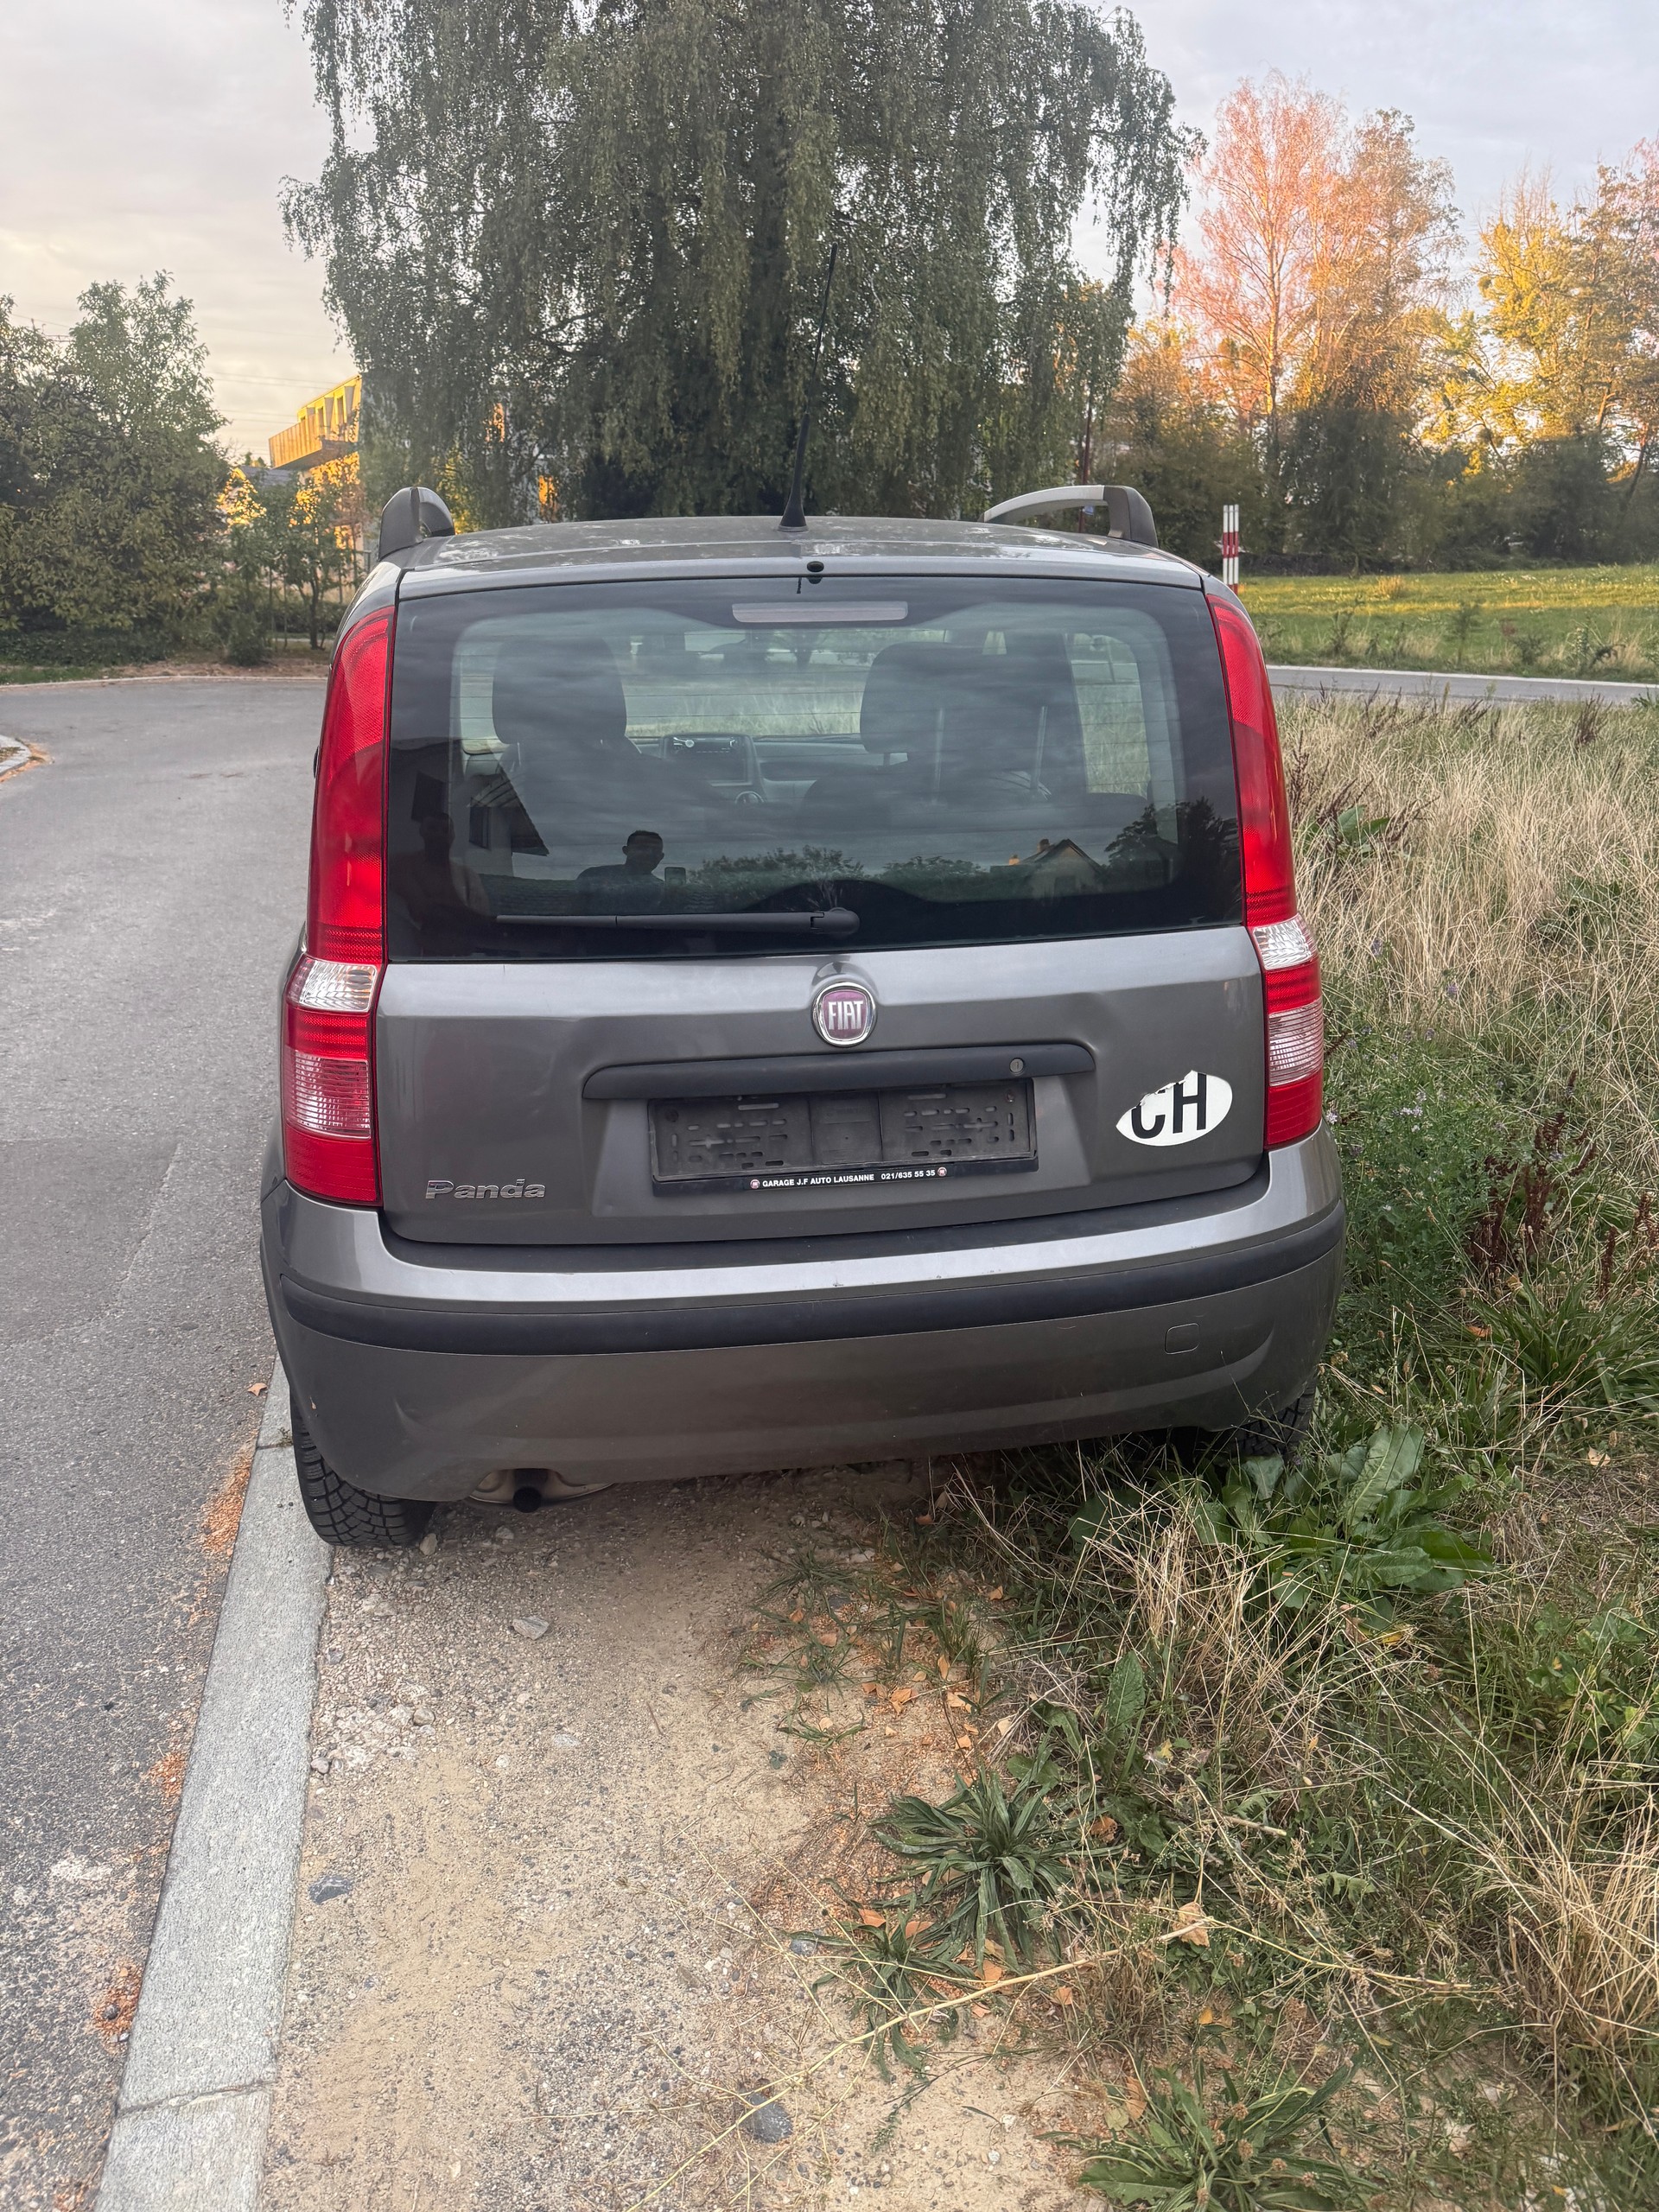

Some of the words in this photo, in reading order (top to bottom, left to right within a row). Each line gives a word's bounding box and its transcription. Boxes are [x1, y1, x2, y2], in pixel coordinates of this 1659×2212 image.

[828, 1001, 864, 1030] FIAT
[1131, 1072, 1207, 1139] CH
[425, 1179, 546, 1199] Panda
[762, 1179, 795, 1187] GARAGE
[833, 1173, 874, 1183] LAUSANNE
[880, 1172, 912, 1180] 021/635
